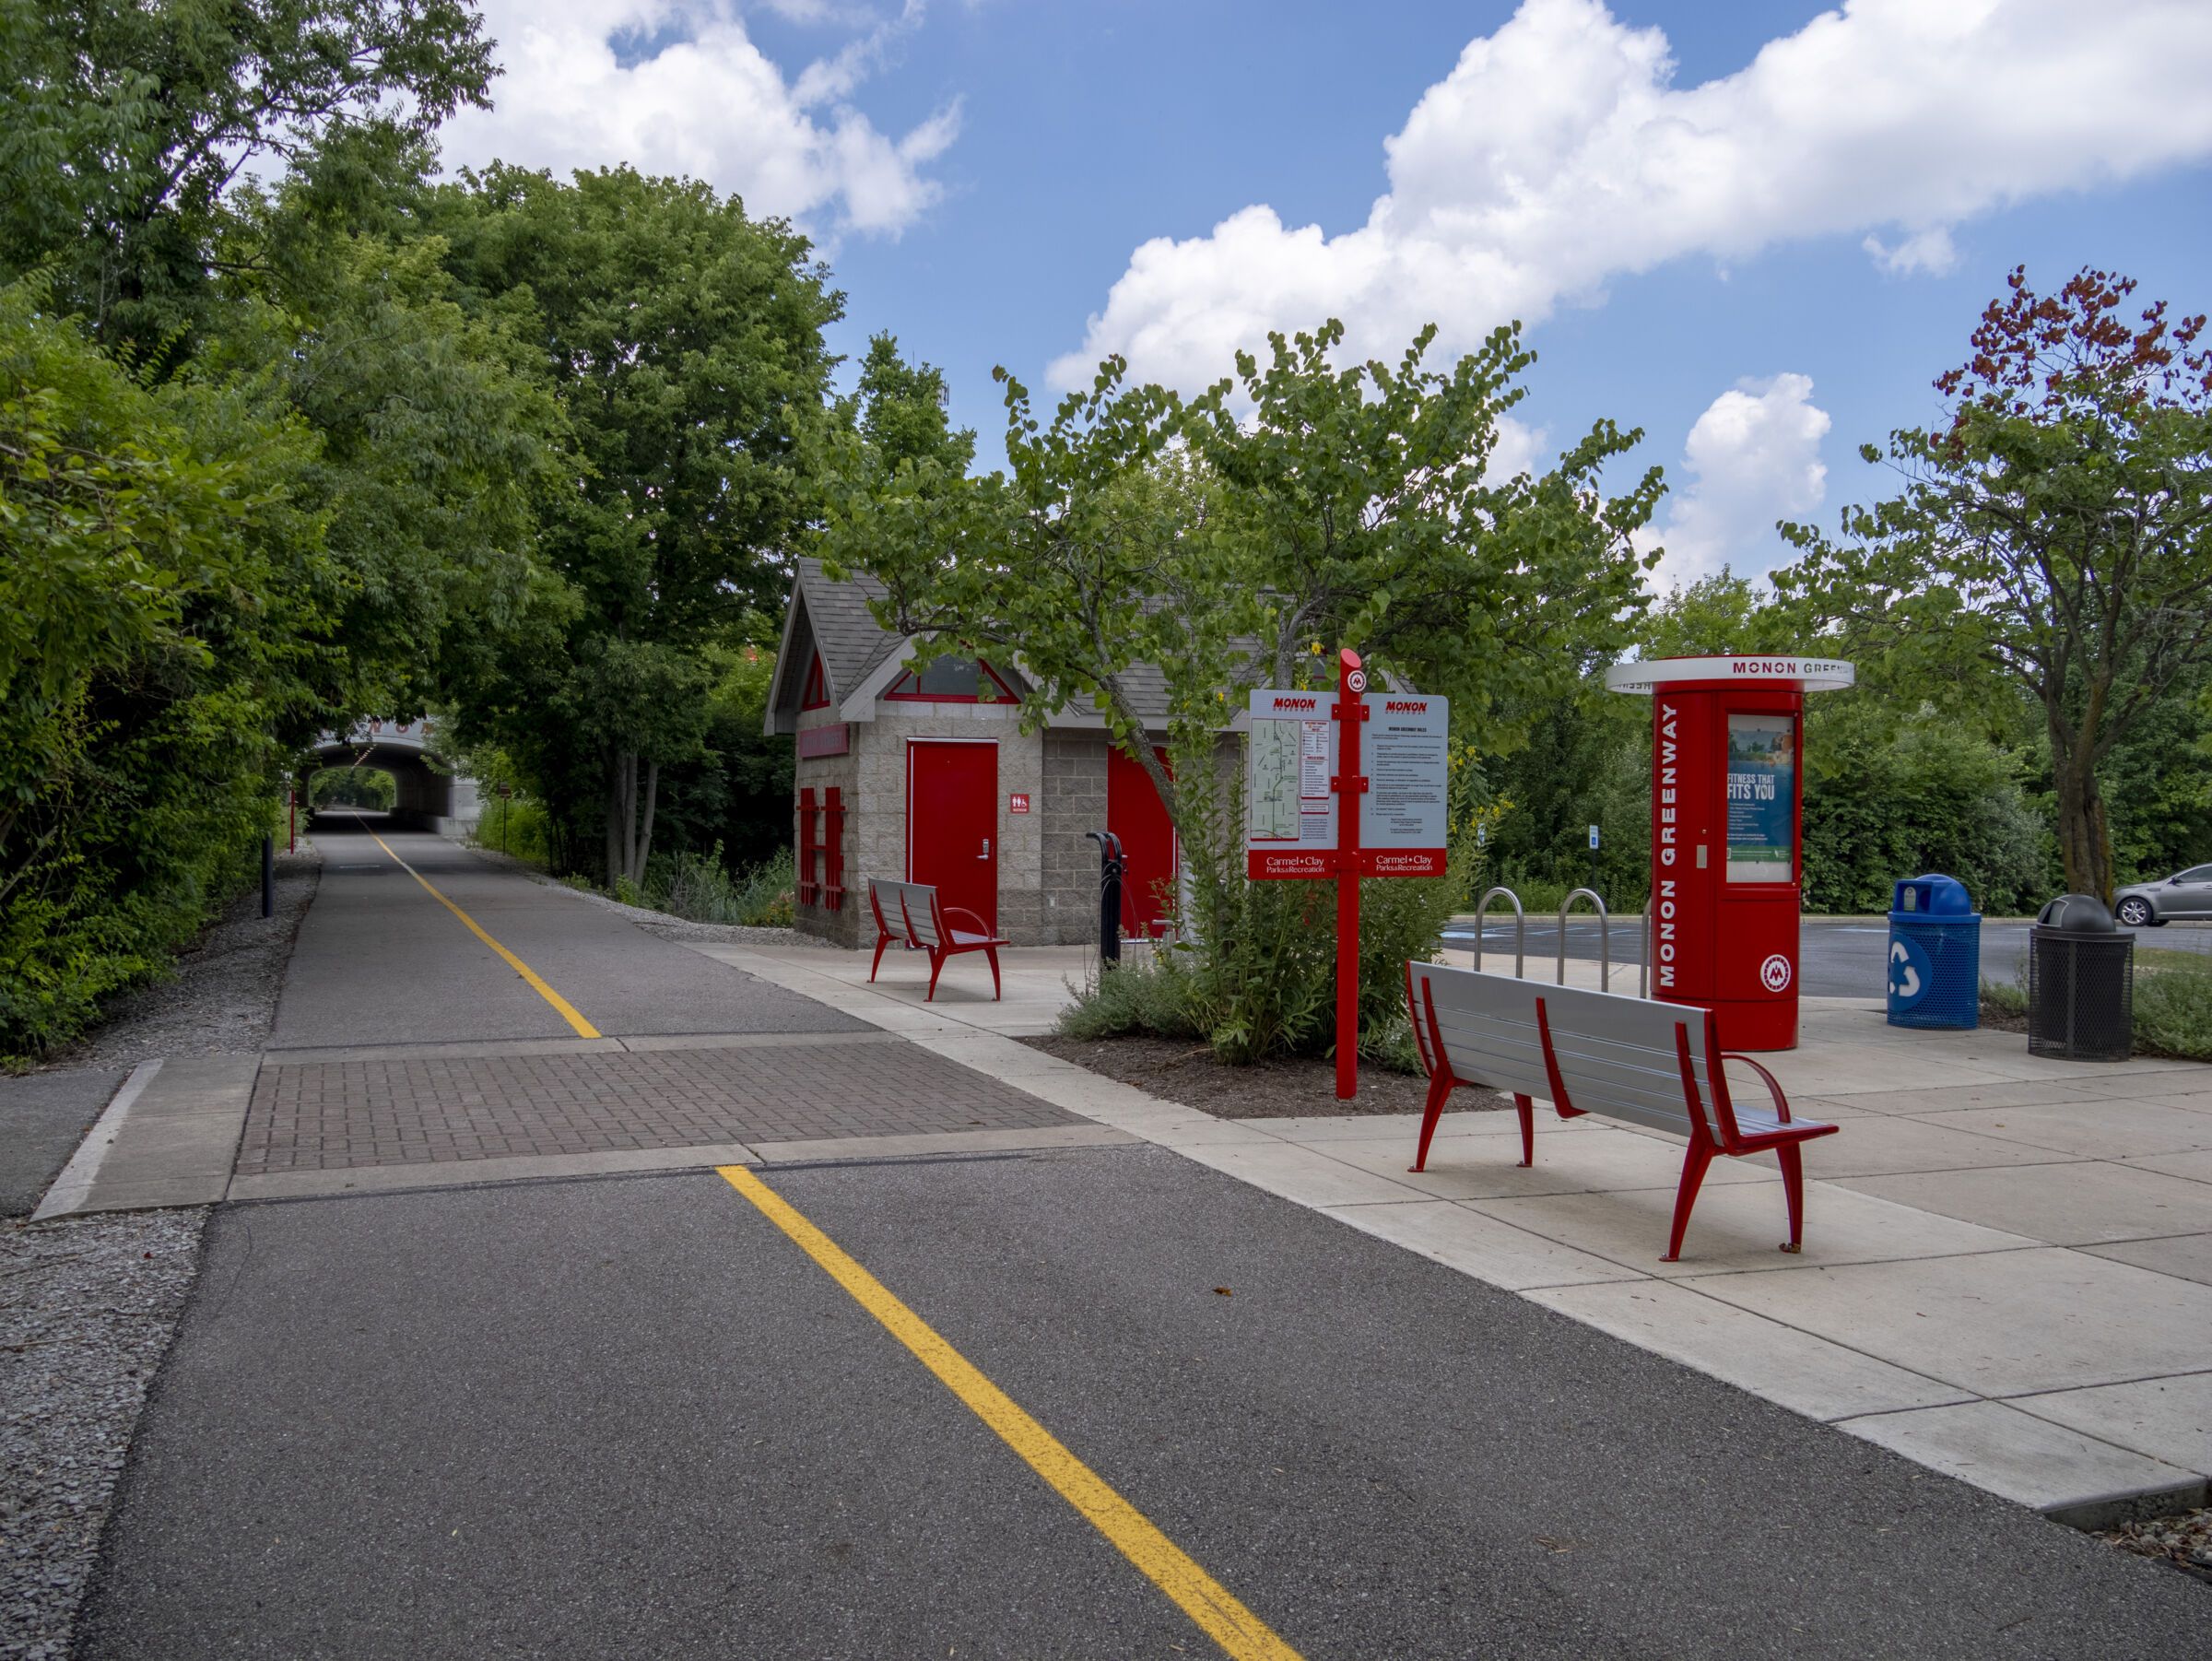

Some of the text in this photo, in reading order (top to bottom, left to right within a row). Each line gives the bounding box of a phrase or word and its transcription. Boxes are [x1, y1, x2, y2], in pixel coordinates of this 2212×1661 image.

[1733, 662, 1796, 674] MONON
[1273, 698, 1316, 709] MONON
[1385, 701, 1428, 713] MONON
[1727, 772, 1775, 784] FITNESS THAT
[1661, 703, 1677, 866] GREENWAY
[1727, 783, 1775, 801] FITS YOU
[1660, 880, 1676, 987] MONON
